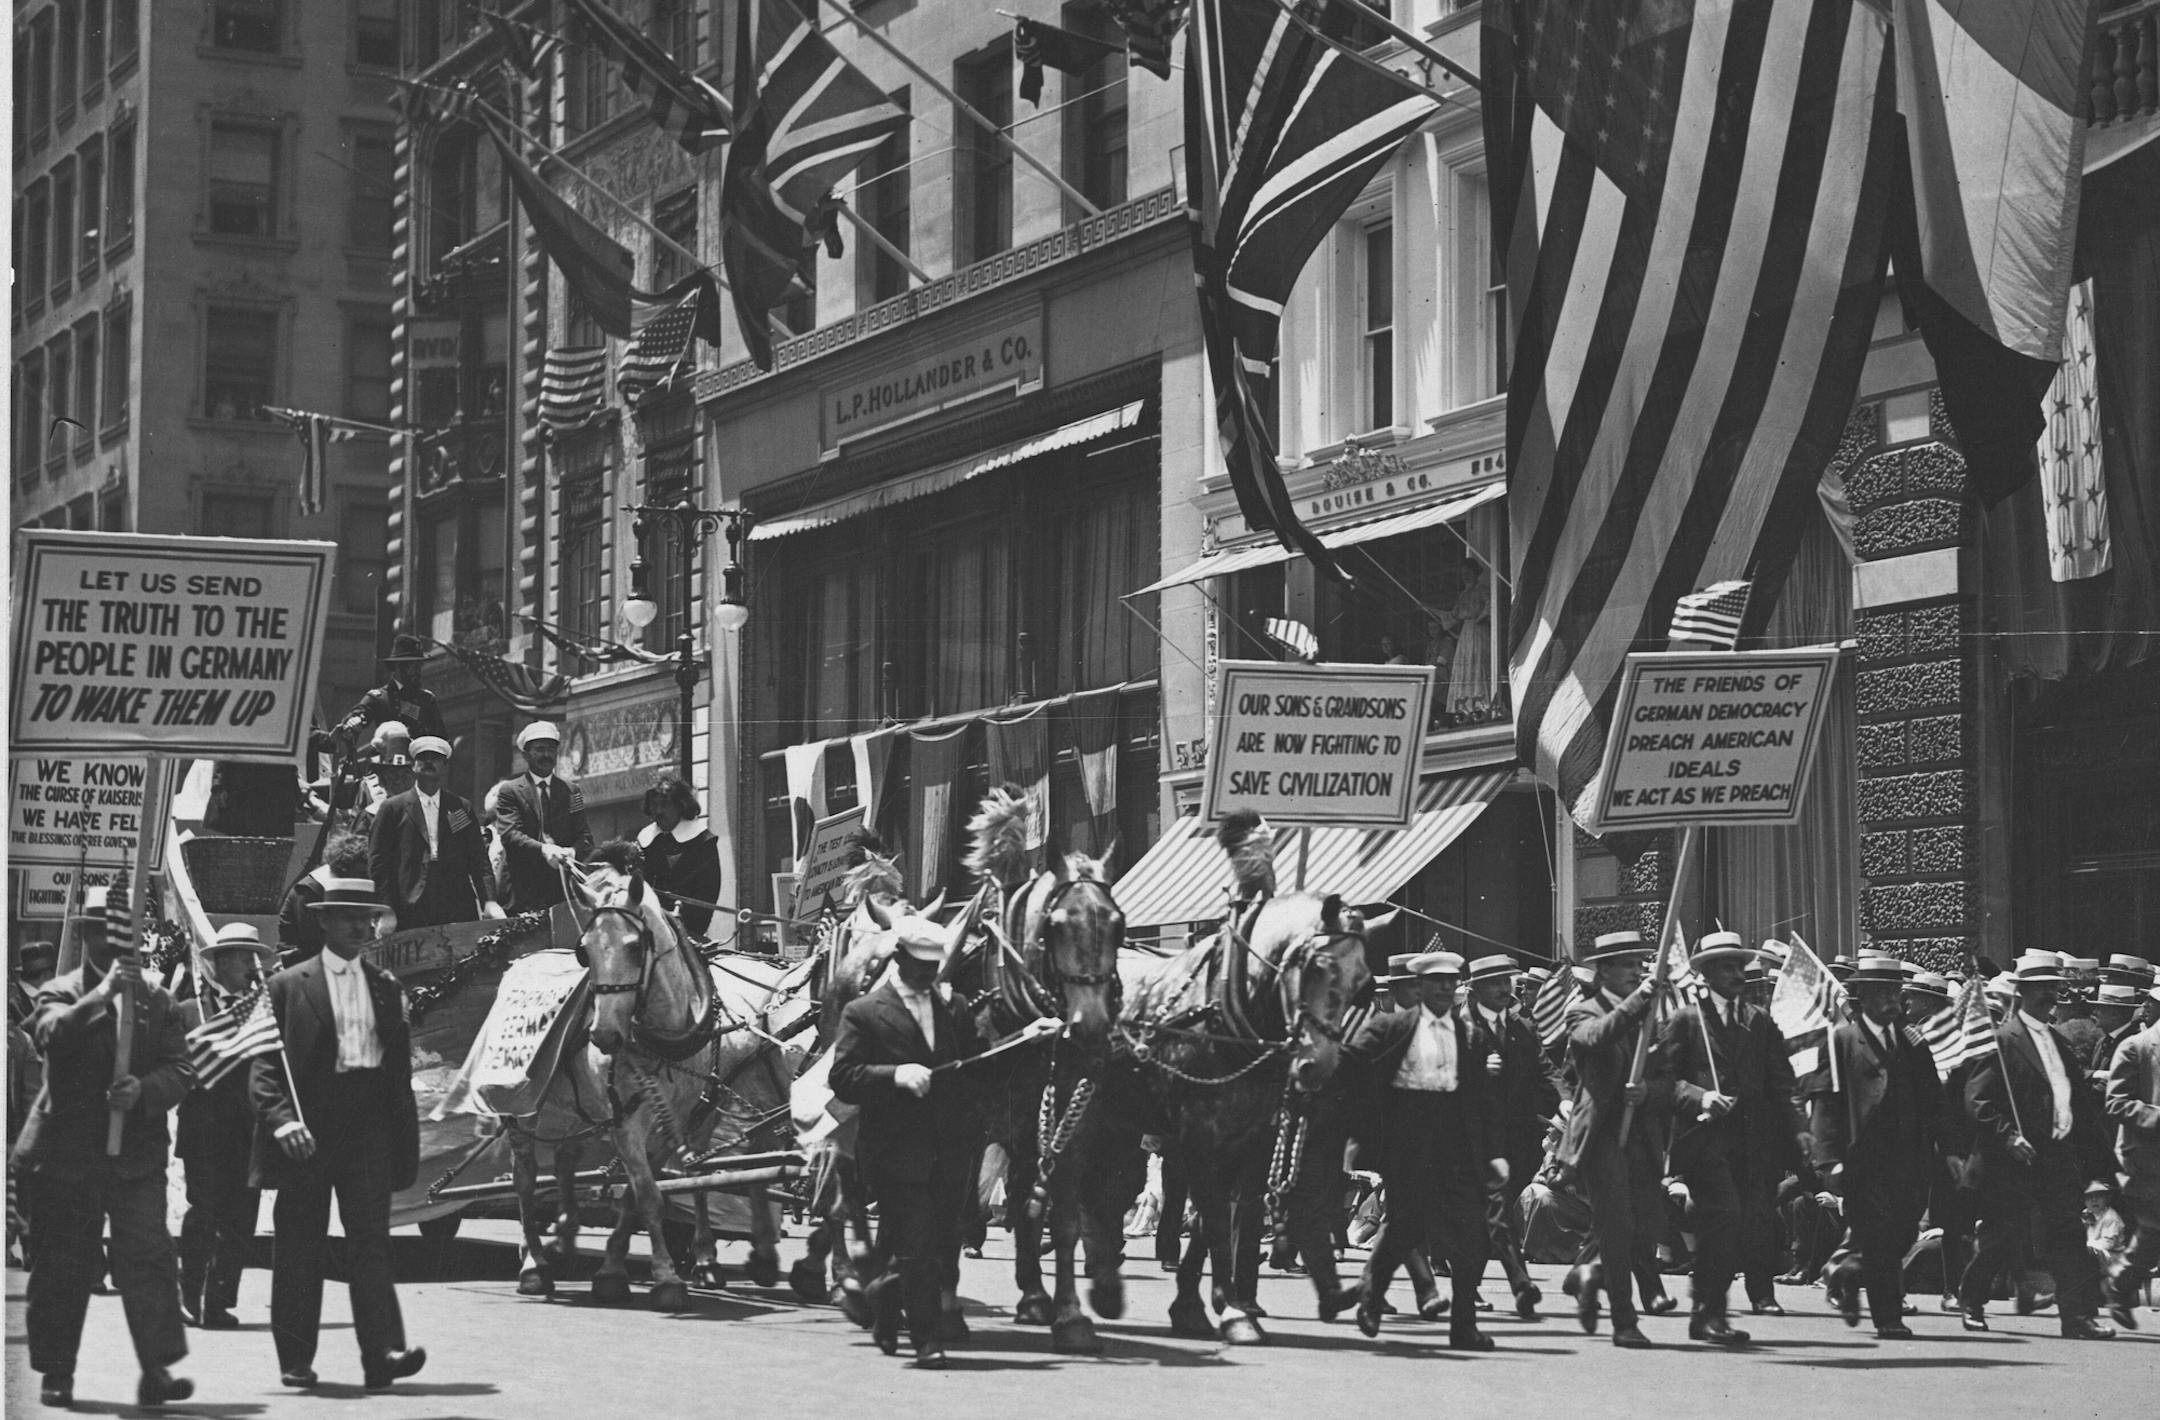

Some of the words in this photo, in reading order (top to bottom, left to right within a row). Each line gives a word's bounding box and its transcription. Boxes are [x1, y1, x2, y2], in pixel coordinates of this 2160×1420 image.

[982, 349, 994, 372] &
[1001, 335, 1032, 365] CO.
[1386, 482, 1396, 497] &
[1407, 474, 1432, 491] CO.
[80, 570, 129, 591] LET
[140, 572, 177, 594] US
[187, 574, 262, 597] SEND
[42, 598, 90, 632] THE
[100, 600, 180, 637] TRUTH
[191, 604, 225, 637] TO
[235, 606, 289, 640] THE
[34, 640, 137, 677] PEOPLE
[147, 645, 172, 679] IN
[180, 645, 293, 681] GERMANY
[1653, 677, 1687, 694] THE
[1693, 675, 1765, 694] FRIENDS
[1774, 674, 1802, 691] OF
[30, 683, 73, 722] TO
[71, 685, 152, 724] WAKE
[152, 689, 231, 726] THEM
[229, 690, 276, 726] UP
[1239, 694, 1270, 716] OUR
[1274, 694, 1310, 717] SONS
[1313, 696, 1323, 718] &
[1324, 696, 1407, 719] GRANDSONS
[1634, 704, 1703, 722] GERMAN
[1707, 701, 1808, 721] DEMOCRACY
[1236, 732, 1266, 753] ARE
[1274, 733, 1308, 754] NOW
[1311, 734, 1379, 756] FIGHTING
[1383, 735, 1402, 755] TO
[1628, 733, 1694, 751] PREACH
[1701, 730, 1793, 750] AMERICAN
[37, 759, 72, 783] WE
[83, 762, 145, 787] KNOW
[1668, 759, 1741, 778] IDEALS
[19, 784, 41, 801] THE
[45, 785, 80, 804] CURSE
[82, 788, 96, 805] OF
[1229, 771, 1271, 795] SAVE
[1278, 772, 1393, 797] CIVILIZATION
[1612, 789, 1634, 807] WE
[1635, 788, 1671, 806] ACT
[1671, 787, 1696, 805] AS
[1702, 786, 1726, 803] WE
[1730, 783, 1792, 802] PREACH
[23, 808, 46, 828] WE
[54, 810, 102, 831] HAVE
[109, 813, 139, 832] FEL
[11, 830, 27, 844] THE
[28, 831, 71, 847] BLESSINGS
[80, 872, 110, 887] SONS
[29, 889, 66, 905] FIGHTING
